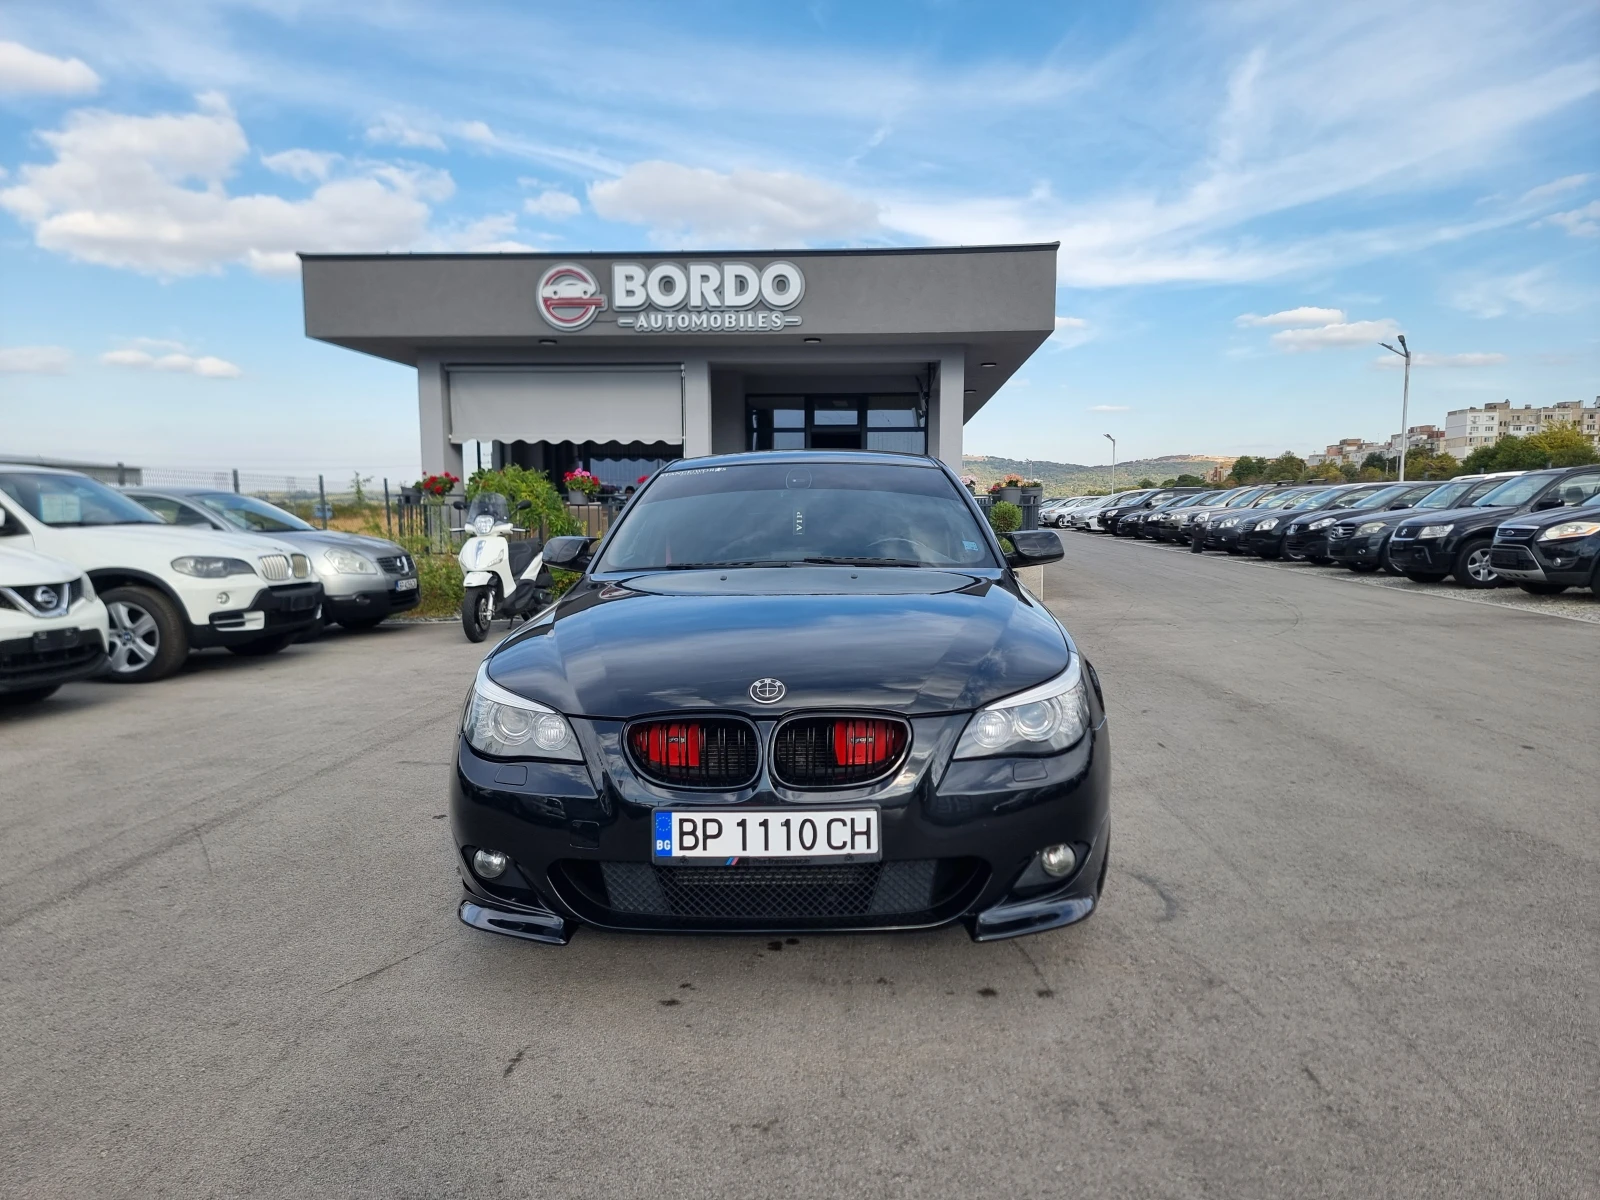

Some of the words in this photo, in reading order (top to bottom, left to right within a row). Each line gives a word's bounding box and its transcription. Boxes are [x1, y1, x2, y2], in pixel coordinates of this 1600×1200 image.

[612, 262, 803, 308] BORDO
[636, 313, 782, 329] AUTOMOBILES
[656, 839, 671, 851] BG
[678, 818, 723, 851] BP
[736, 818, 818, 851] 1110
[826, 817, 872, 850] CH
